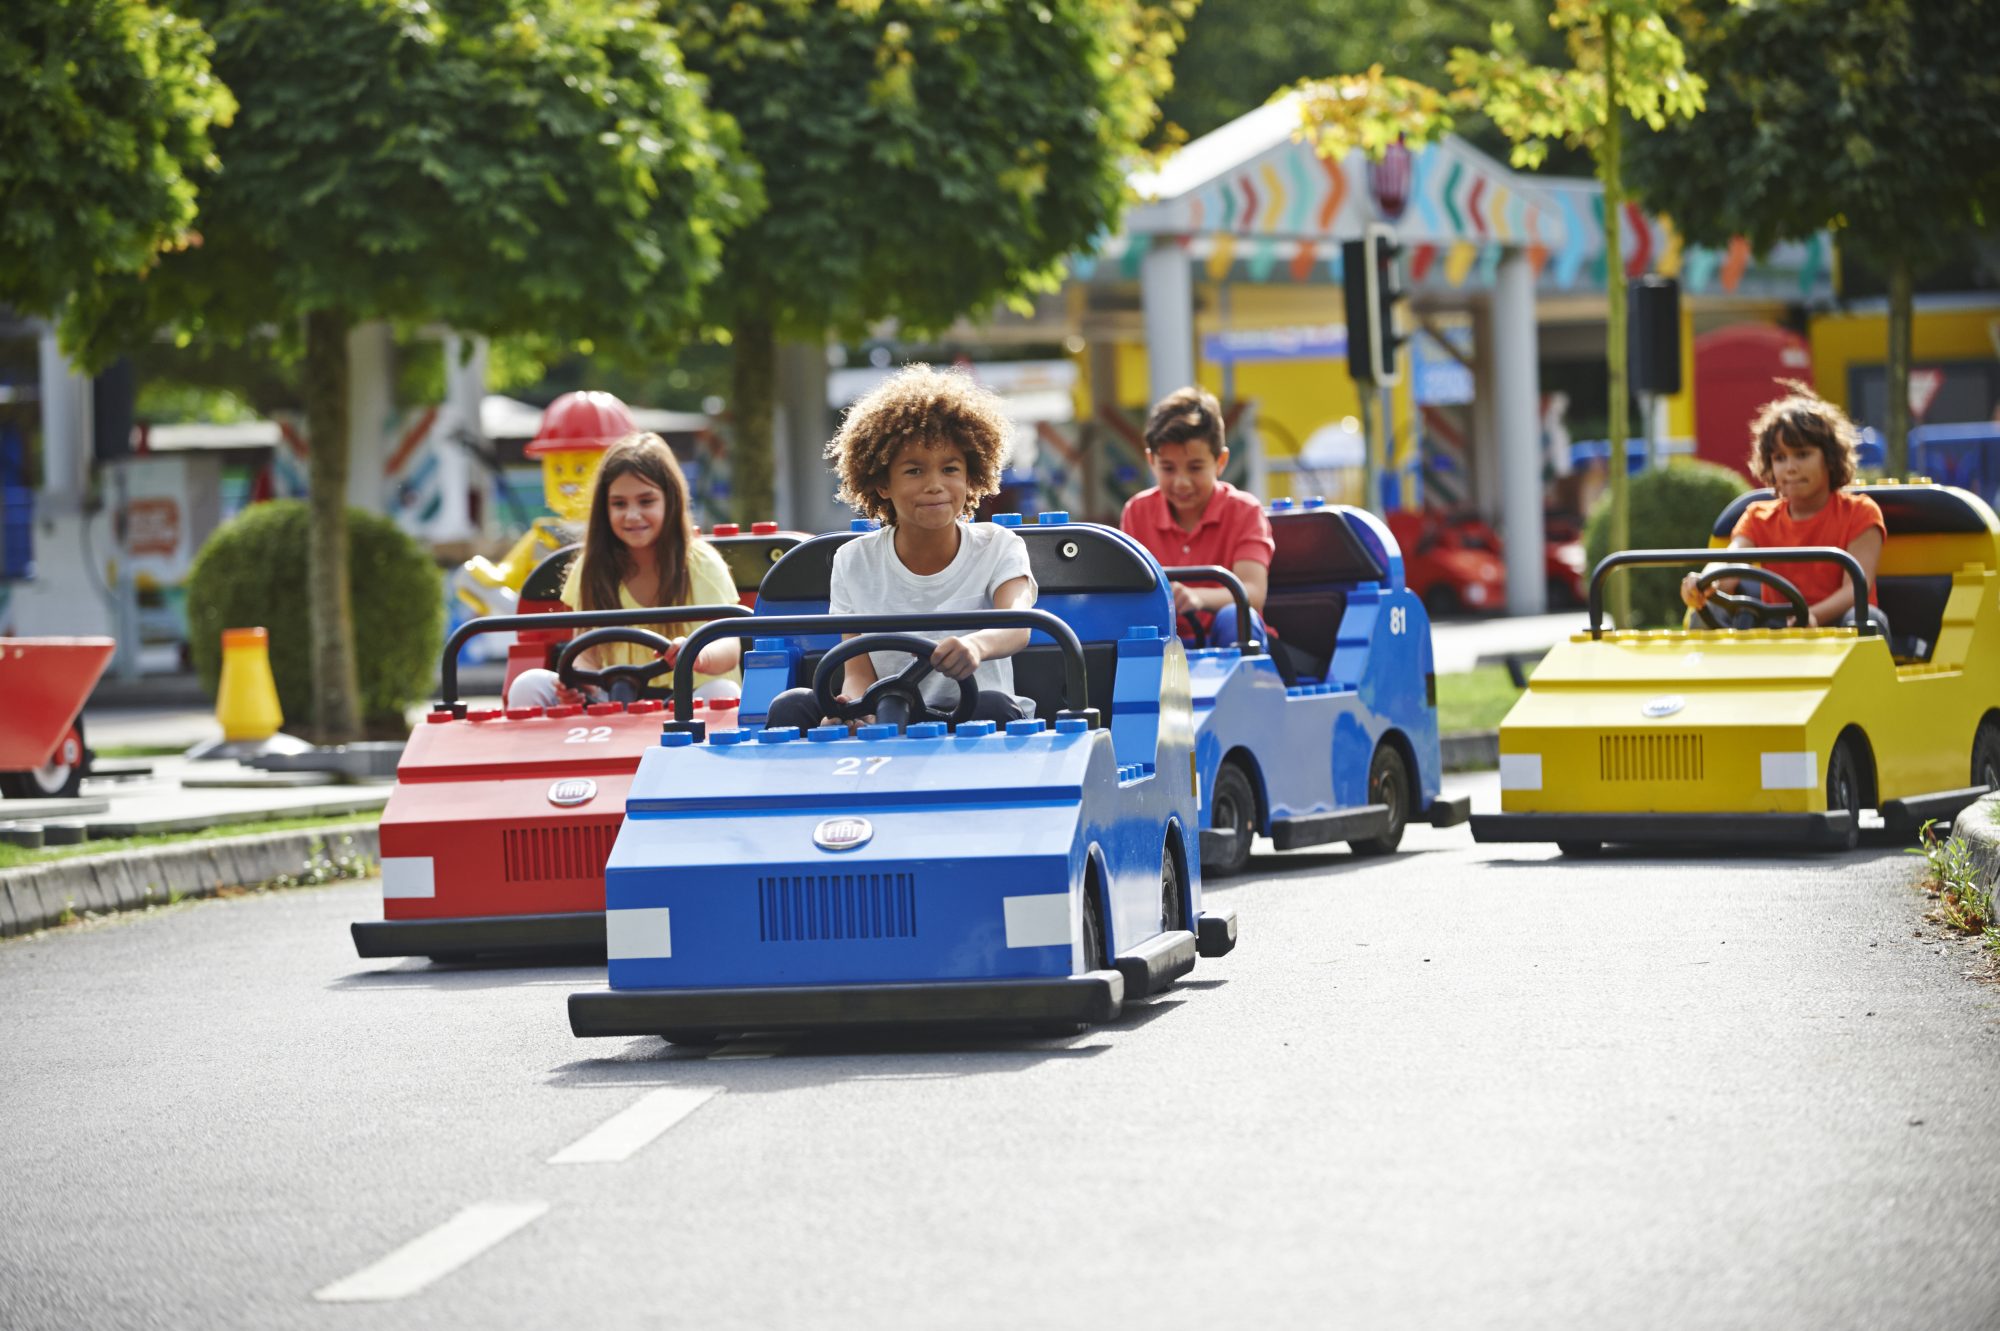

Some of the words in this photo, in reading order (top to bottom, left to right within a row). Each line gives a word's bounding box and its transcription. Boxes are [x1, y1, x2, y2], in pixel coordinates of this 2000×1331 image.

[1390, 606, 1406, 635] 81
[563, 726, 613, 743] 22
[831, 757, 892, 775] 27
[825, 824, 861, 839] FIAT
